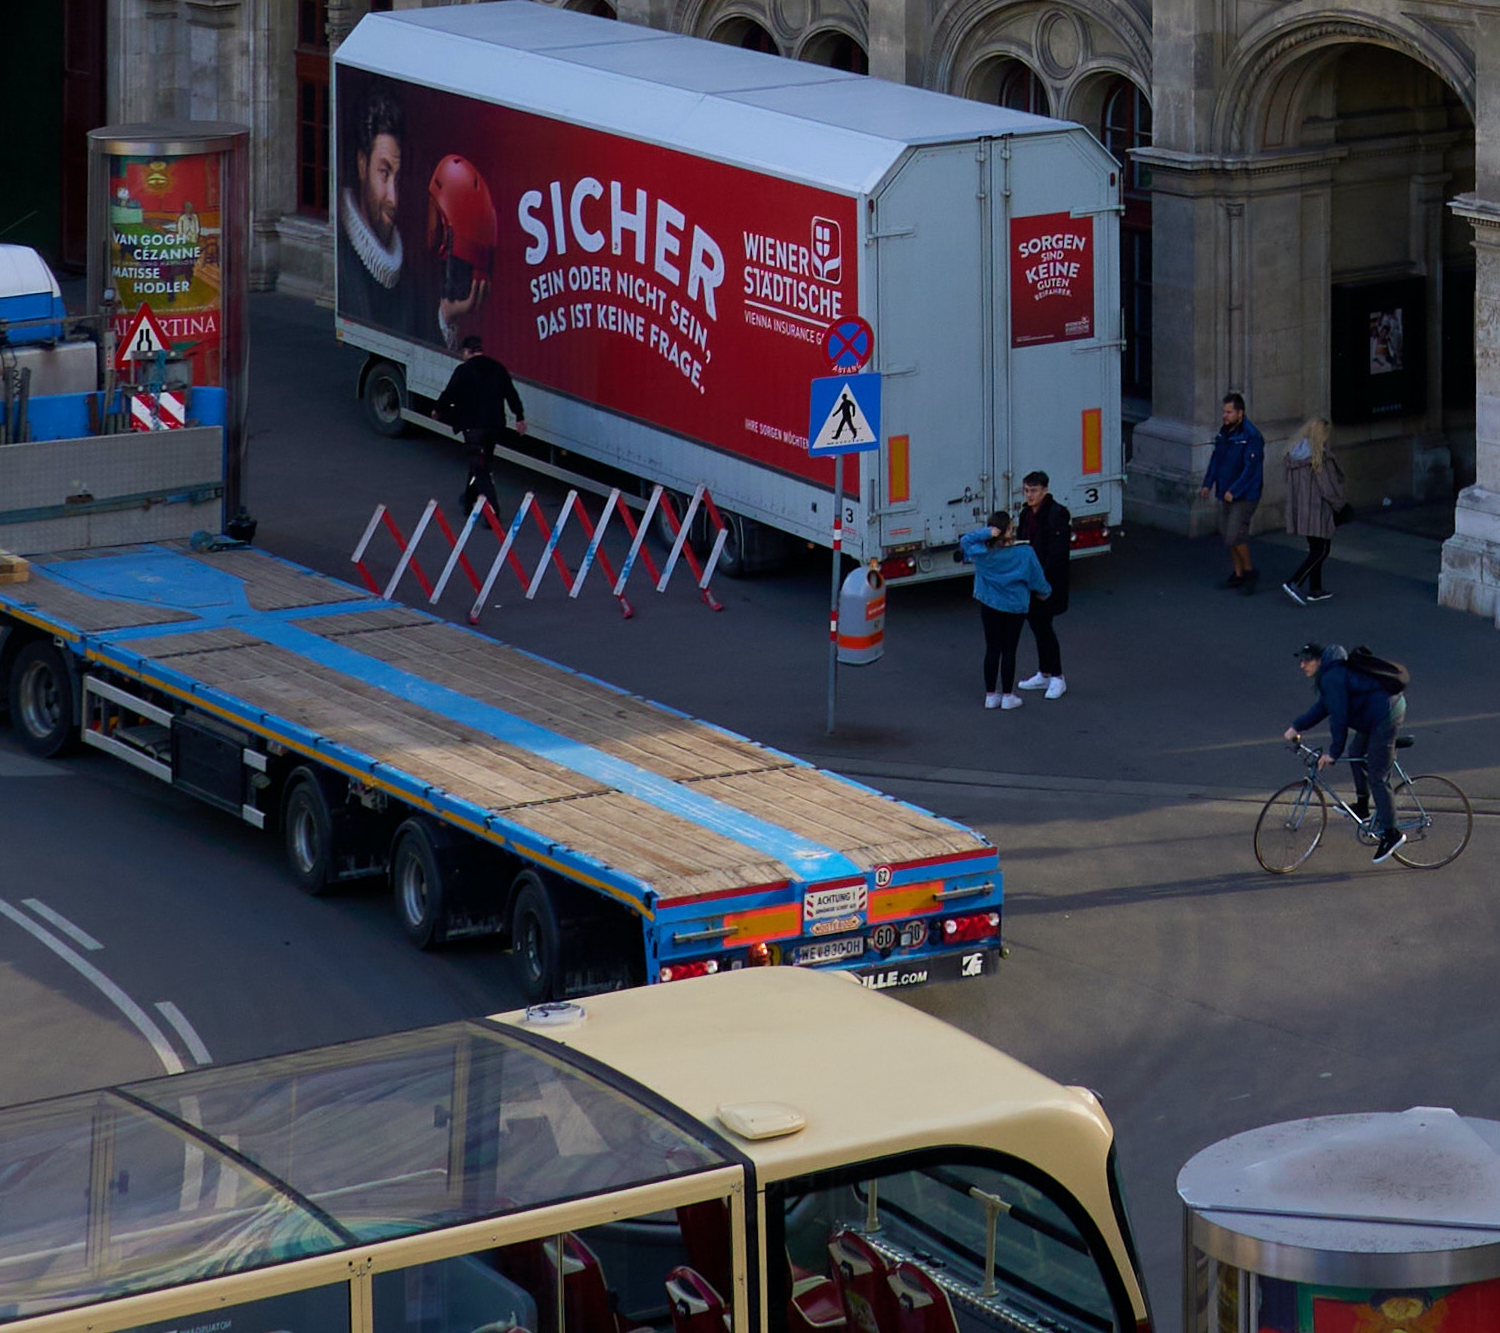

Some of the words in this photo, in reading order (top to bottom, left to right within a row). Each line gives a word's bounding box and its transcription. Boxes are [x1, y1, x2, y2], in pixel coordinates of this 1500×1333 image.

[113, 233, 137, 246] VAN
[140, 234, 187, 247] GOGH
[1018, 234, 1087, 259] SORGEN
[133, 247, 201, 260] CÉZANNE
[518, 176, 725, 322] SICHER
[743, 230, 810, 277] WIENER
[1040, 251, 1064, 263] SIND
[112, 266, 160, 279] MATISSE
[1025, 262, 1081, 285] KEINE
[133, 280, 190, 294] HODLER
[1037, 277, 1070, 291] GUTEN
[743, 265, 842, 320] STÄDTISCHE
[530, 269, 565, 304] SEIN
[568, 265, 611, 293] ODER
[616, 269, 667, 316] NICHT
[669, 299, 711, 364] SEIN,
[744, 310, 773, 330] VIENNA
[773, 319, 816, 345] INSURANCE
[536, 306, 567, 341] DAS
[570, 302, 593, 330] IST
[596, 303, 646, 343] KEINE
[649, 323, 706, 396] FRAGE.
[759, 422, 782, 442] SORGEN
[1085, 488, 1100, 504] 3
[845, 508, 854, 524] 3
[877, 868, 888, 883] 62
[817, 892, 851, 906] ACHTUNG
[877, 928, 892, 944] 60
